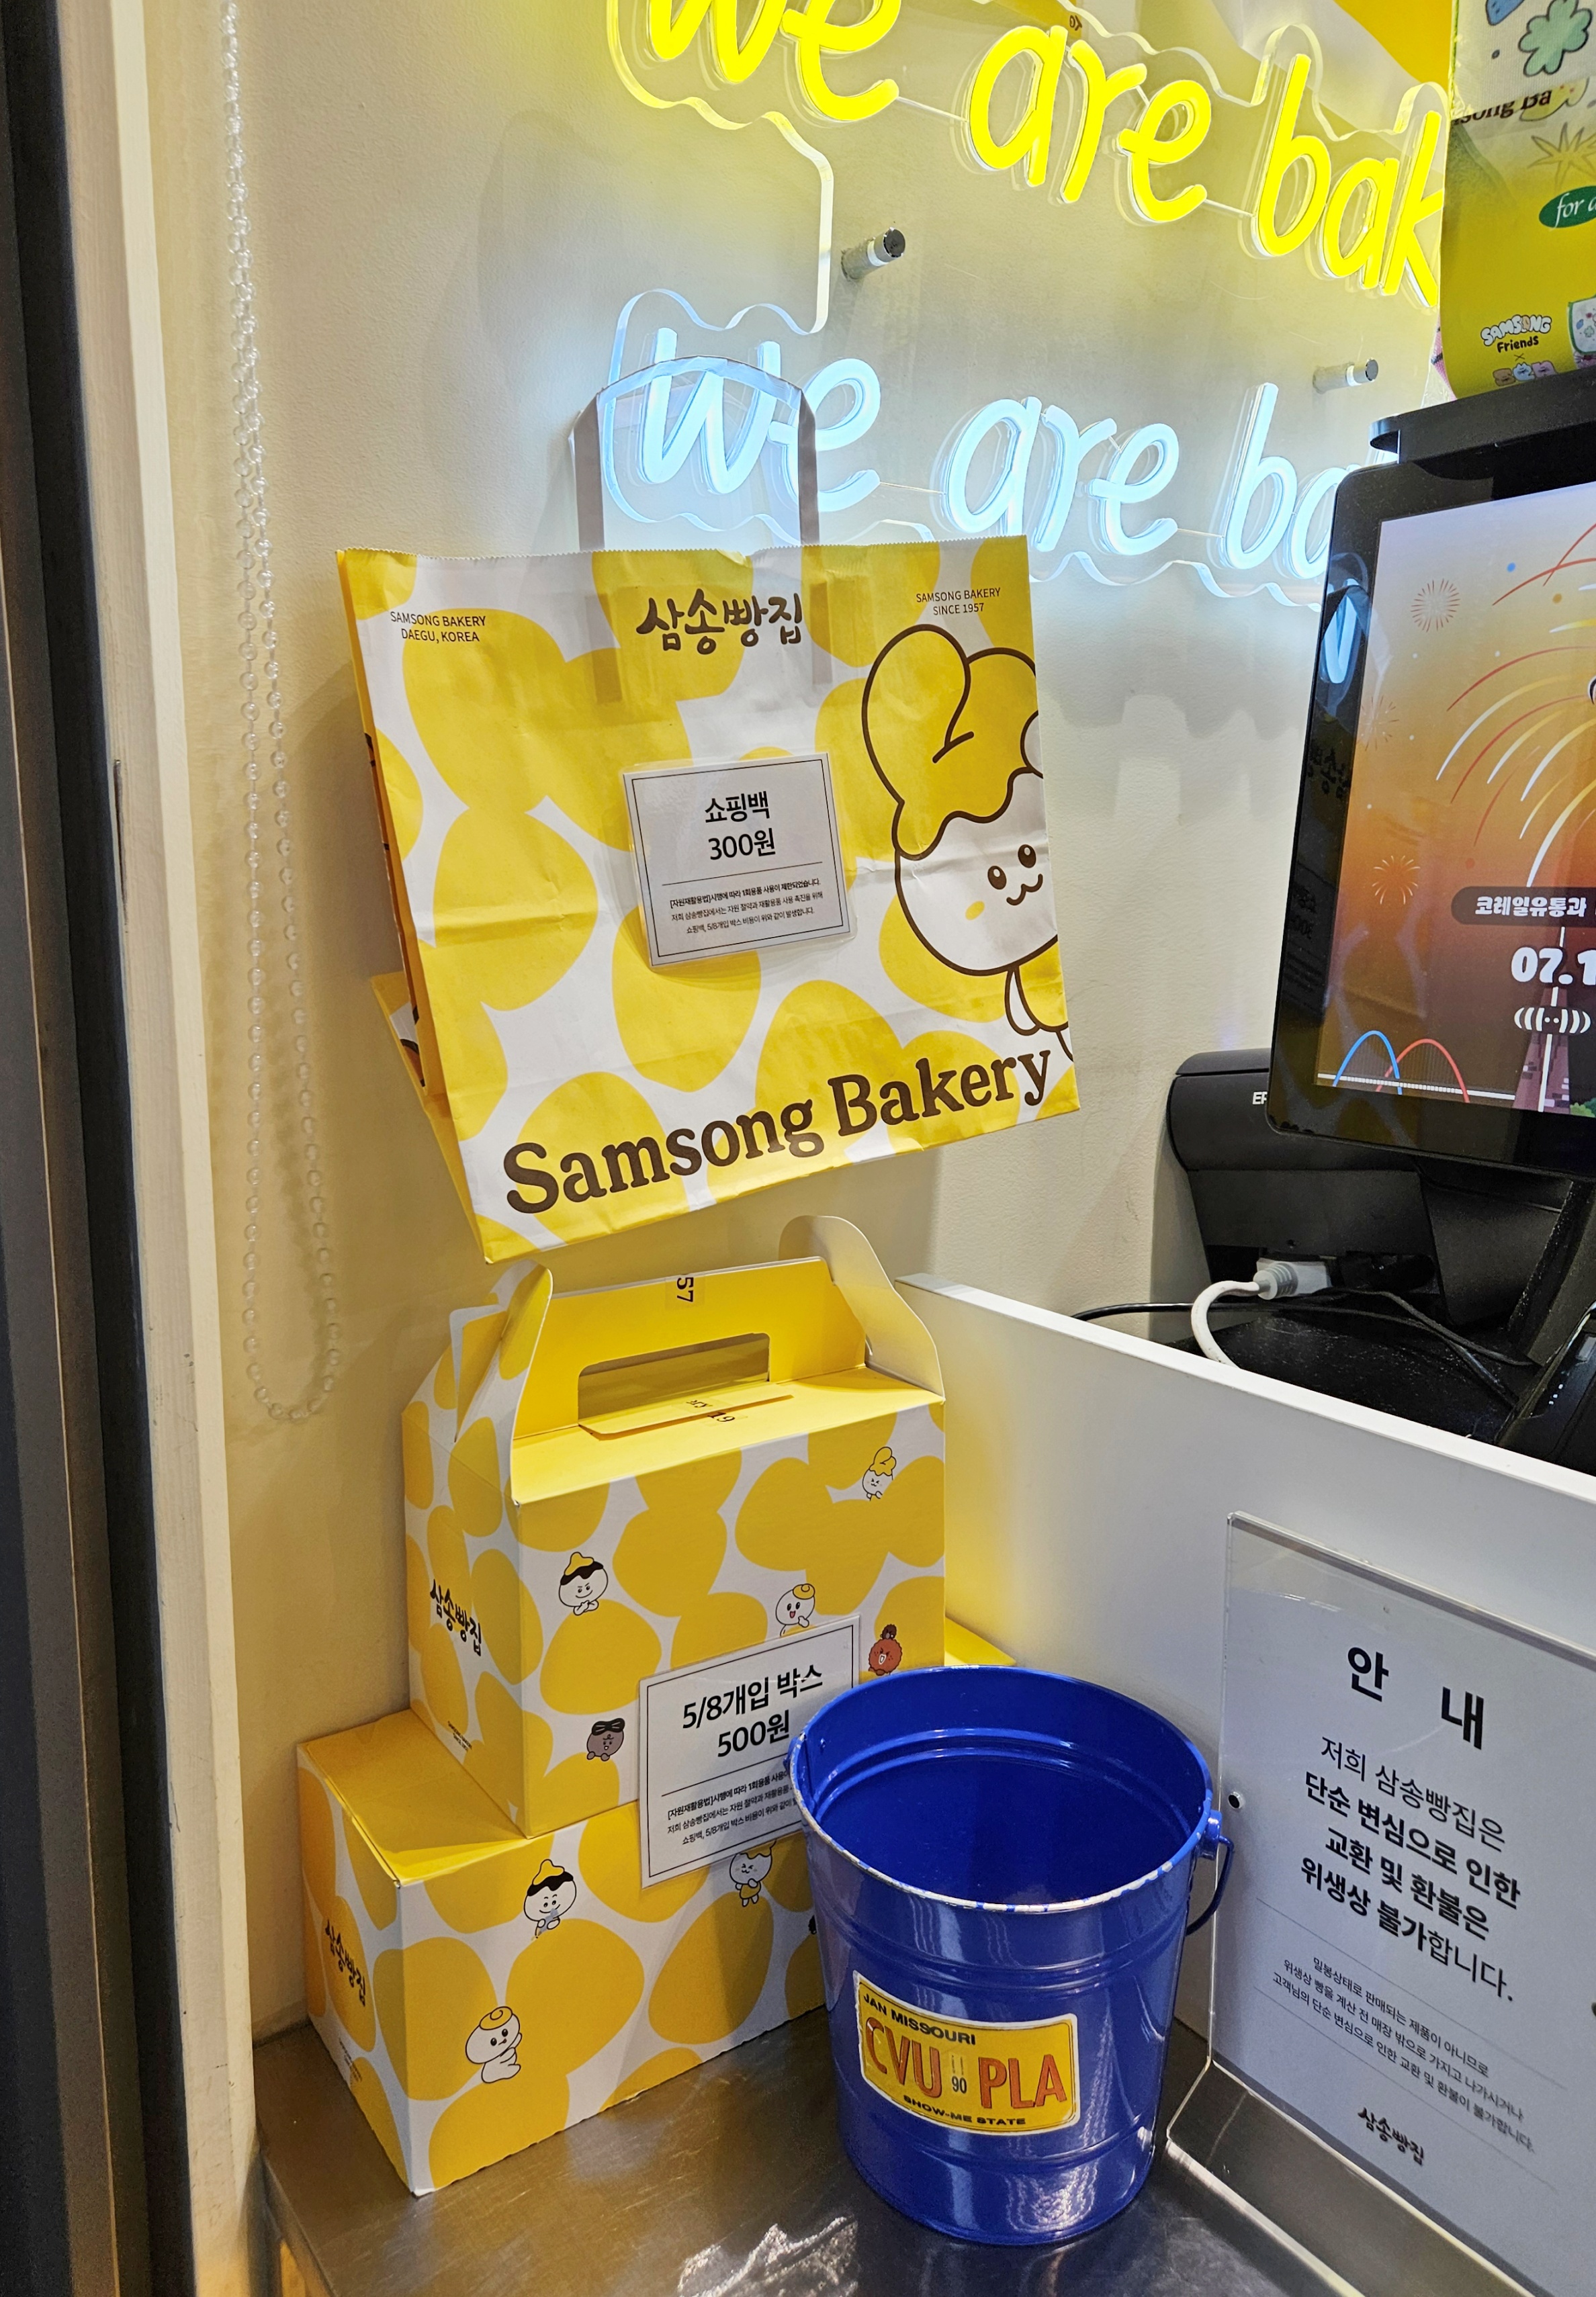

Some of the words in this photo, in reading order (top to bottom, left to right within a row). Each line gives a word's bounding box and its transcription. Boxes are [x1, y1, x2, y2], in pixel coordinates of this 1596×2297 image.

[970, 26, 1211, 222] are
[1550, 192, 1583, 230] for
[1497, 335, 1539, 353] Friends
[944, 396, 1180, 555] are
[390, 611, 440, 626] SAMSONG
[442, 615, 486, 627] BAKERY
[916, 591, 961, 603] SAMSONG
[964, 587, 1001, 599] BAKERY
[933, 604, 961, 615] SINCE
[963, 602, 985, 613] 1957
[401, 628, 439, 643] DAEGU,
[441, 631, 480, 642] KOREA
[636, 588, 803, 656] 삼송빵집
[705, 791, 770, 823] 쇼핑백
[708, 827, 777, 860] 300원
[672, 913, 684, 921] 저희
[685, 905, 727, 920] 삼송빵집에서는
[727, 905, 740, 913] 자원
[812, 891, 824, 899] 위해
[763, 884, 781, 893] 사용이
[1475, 896, 1587, 917] 코레일유통과
[707, 920, 729, 931] 5/8개입
[730, 918, 742, 926] 박스
[742, 915, 760, 924] 비용이
[761, 913, 772, 921] 위와
[774, 911, 785, 919] 같이
[502, 1098, 825, 1214] Samsong
[828, 1049, 1051, 1137] Bakery
[430, 1578, 482, 1657] 삼송빵집
[682, 1676, 769, 1729] 5/8개입
[777, 1664, 824, 1700] 박스
[1347, 1647, 1389, 1702] 안
[1441, 1686, 1484, 1750] 내
[717, 1709, 790, 1758] 500원
[734, 1785, 747, 1795] 따라
[748, 1778, 770, 1791] 1회용품
[1321, 1737, 1366, 1781] 저희
[1375, 1765, 1506, 1852] 삼송빵집은
[667, 1823, 681, 1834] 저희
[682, 1807, 729, 1830] 삼송빵집에서는
[729, 1801, 743, 1811] 자원
[682, 1833, 705, 1846] 쇼핑백,
[705, 1822, 730, 1838] 5/8개입
[731, 1816, 745, 1827] 박스
[1304, 1770, 1351, 1817] 단순
[1358, 1799, 1458, 1875] 변심으로
[1466, 1858, 1521, 1909] 인한
[1325, 1828, 1373, 1875] 교환
[1380, 1856, 1403, 1893] 및
[1411, 1873, 1490, 1940] 환불은
[1301, 1858, 1372, 1916] 위생상
[1378, 1899, 1514, 2002] 불가합니다.
[325, 1919, 366, 2007] 삼송빵집
[864, 1993, 887, 2016] JAN
[891, 2009, 976, 2046] MISSOURI
[1284, 1959, 1312, 1985] 위생상
[1315, 1979, 1334, 2001] 빵을
[1336, 1993, 1357, 2016] 계산
[1359, 2008, 1369, 2024] 전
[1372, 2017, 1392, 2038] 매장
[1395, 2030, 1427, 2061] 밖으로
[1429, 2053, 1462, 2083] 가지고
[1465, 2076, 1524, 2122] 나가시거나
[1313, 1957, 1363, 1997] 밀봉상태로
[1366, 1990, 1407, 2026] 판매되는
[1409, 2018, 1442, 2048] 제품이
[1444, 2041, 1489, 2078] 아니므로
[864, 2016, 942, 2098] CVU
[951, 2075, 967, 2093] 90
[978, 2054, 1067, 2109] PLA
[1273, 1972, 1310, 2006] 고객님의
[1313, 1998, 1332, 2020] 단순
[1334, 2013, 1374, 2048] 변심으로
[1376, 2042, 1398, 2063] 인한
[1399, 2056, 1421, 2079] 교환
[1423, 2071, 1435, 2089] 및
[1437, 2080, 1470, 2111] 환불이
[1473, 2103, 1535, 2154] 불가합니다.
[903, 2095, 973, 2123] SHOW-ME
[977, 2117, 1026, 2125] STATE
[1358, 2107, 1425, 2167] 삼송빵집
